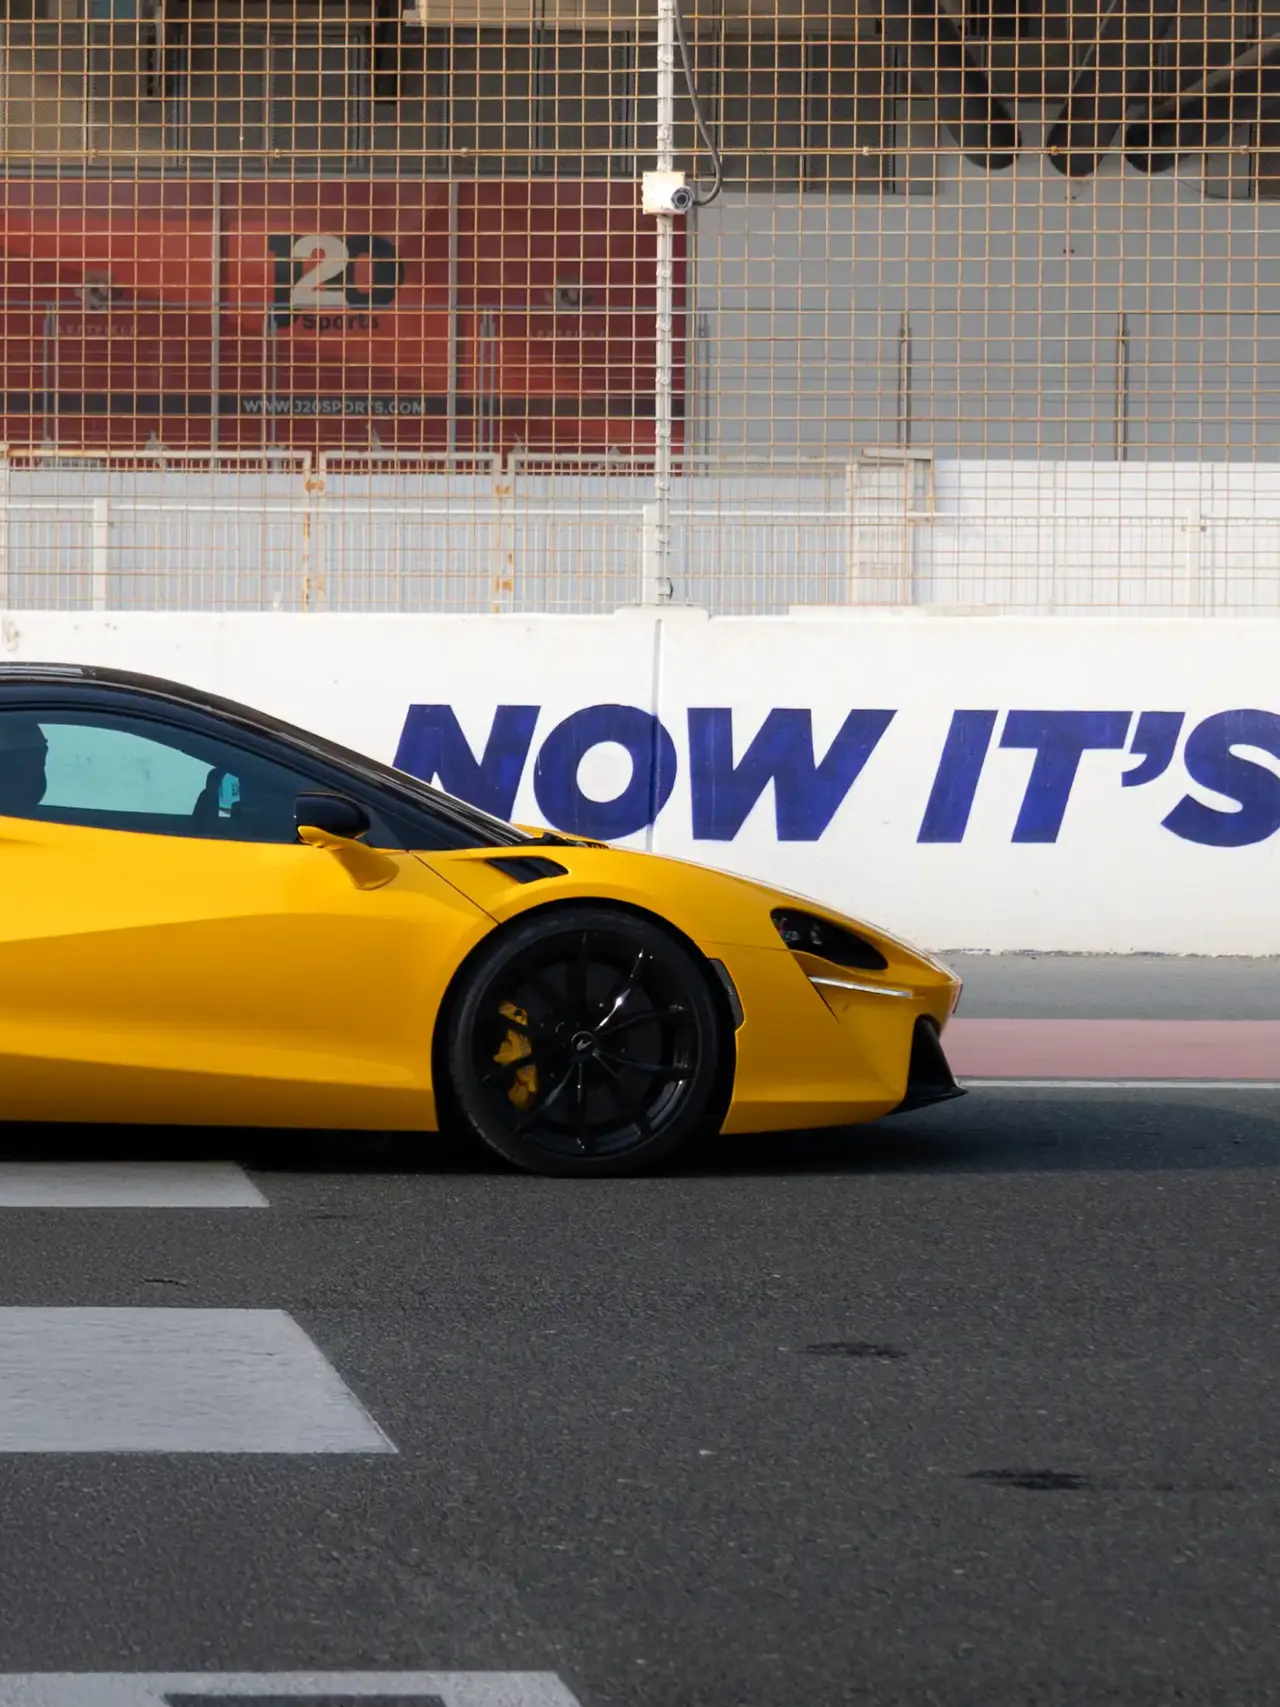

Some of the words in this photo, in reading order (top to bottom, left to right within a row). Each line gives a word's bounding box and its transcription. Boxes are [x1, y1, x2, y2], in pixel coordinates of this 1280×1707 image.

[302, 313, 380, 334] Sports
[243, 399, 426, 415] WWWJ20SPORS.COM
[392, 704, 898, 843] NOW
[917, 708, 1280, 848] IT'S
